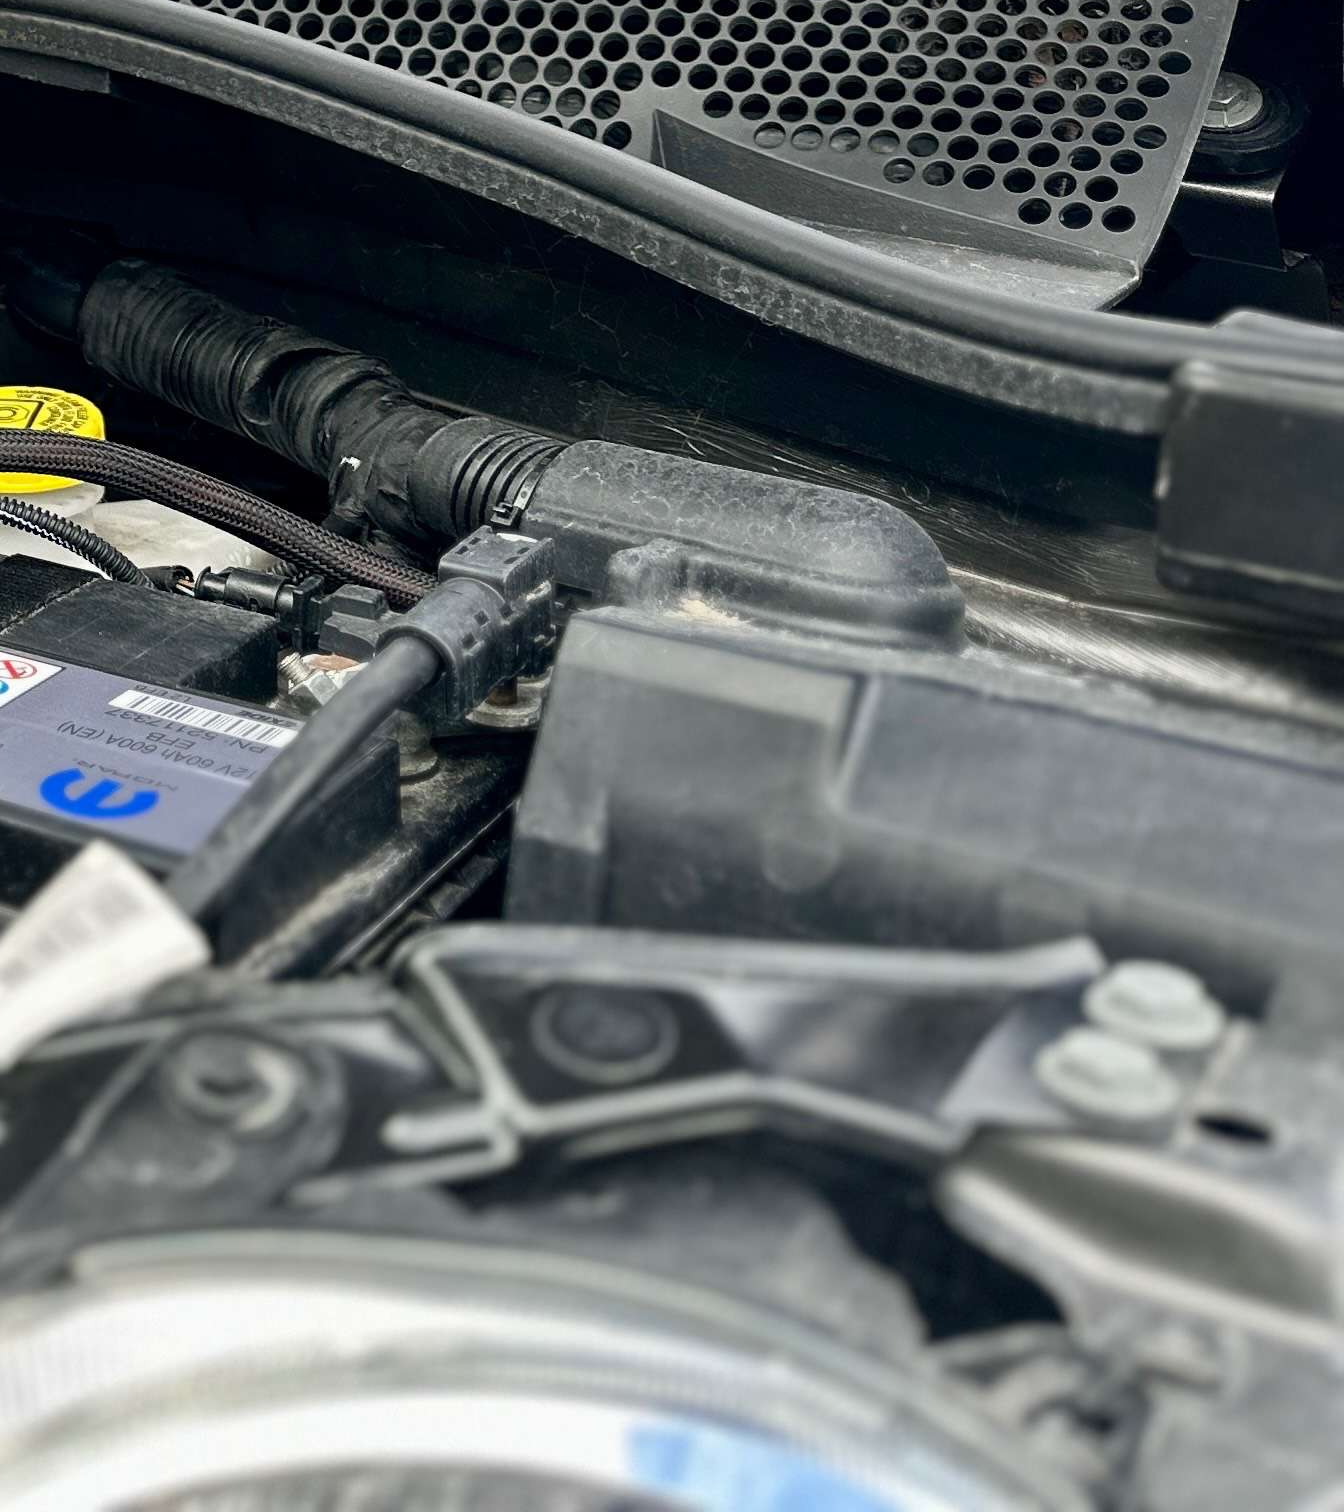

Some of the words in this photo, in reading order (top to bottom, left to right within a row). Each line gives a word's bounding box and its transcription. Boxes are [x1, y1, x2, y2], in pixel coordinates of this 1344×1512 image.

[56, 720, 105, 741] (EN)
[104, 708, 218, 741] 52117337
[105, 734, 158, 754] 600A
[146, 731, 196, 750] EFB
[160, 748, 214, 769] 60Ah
